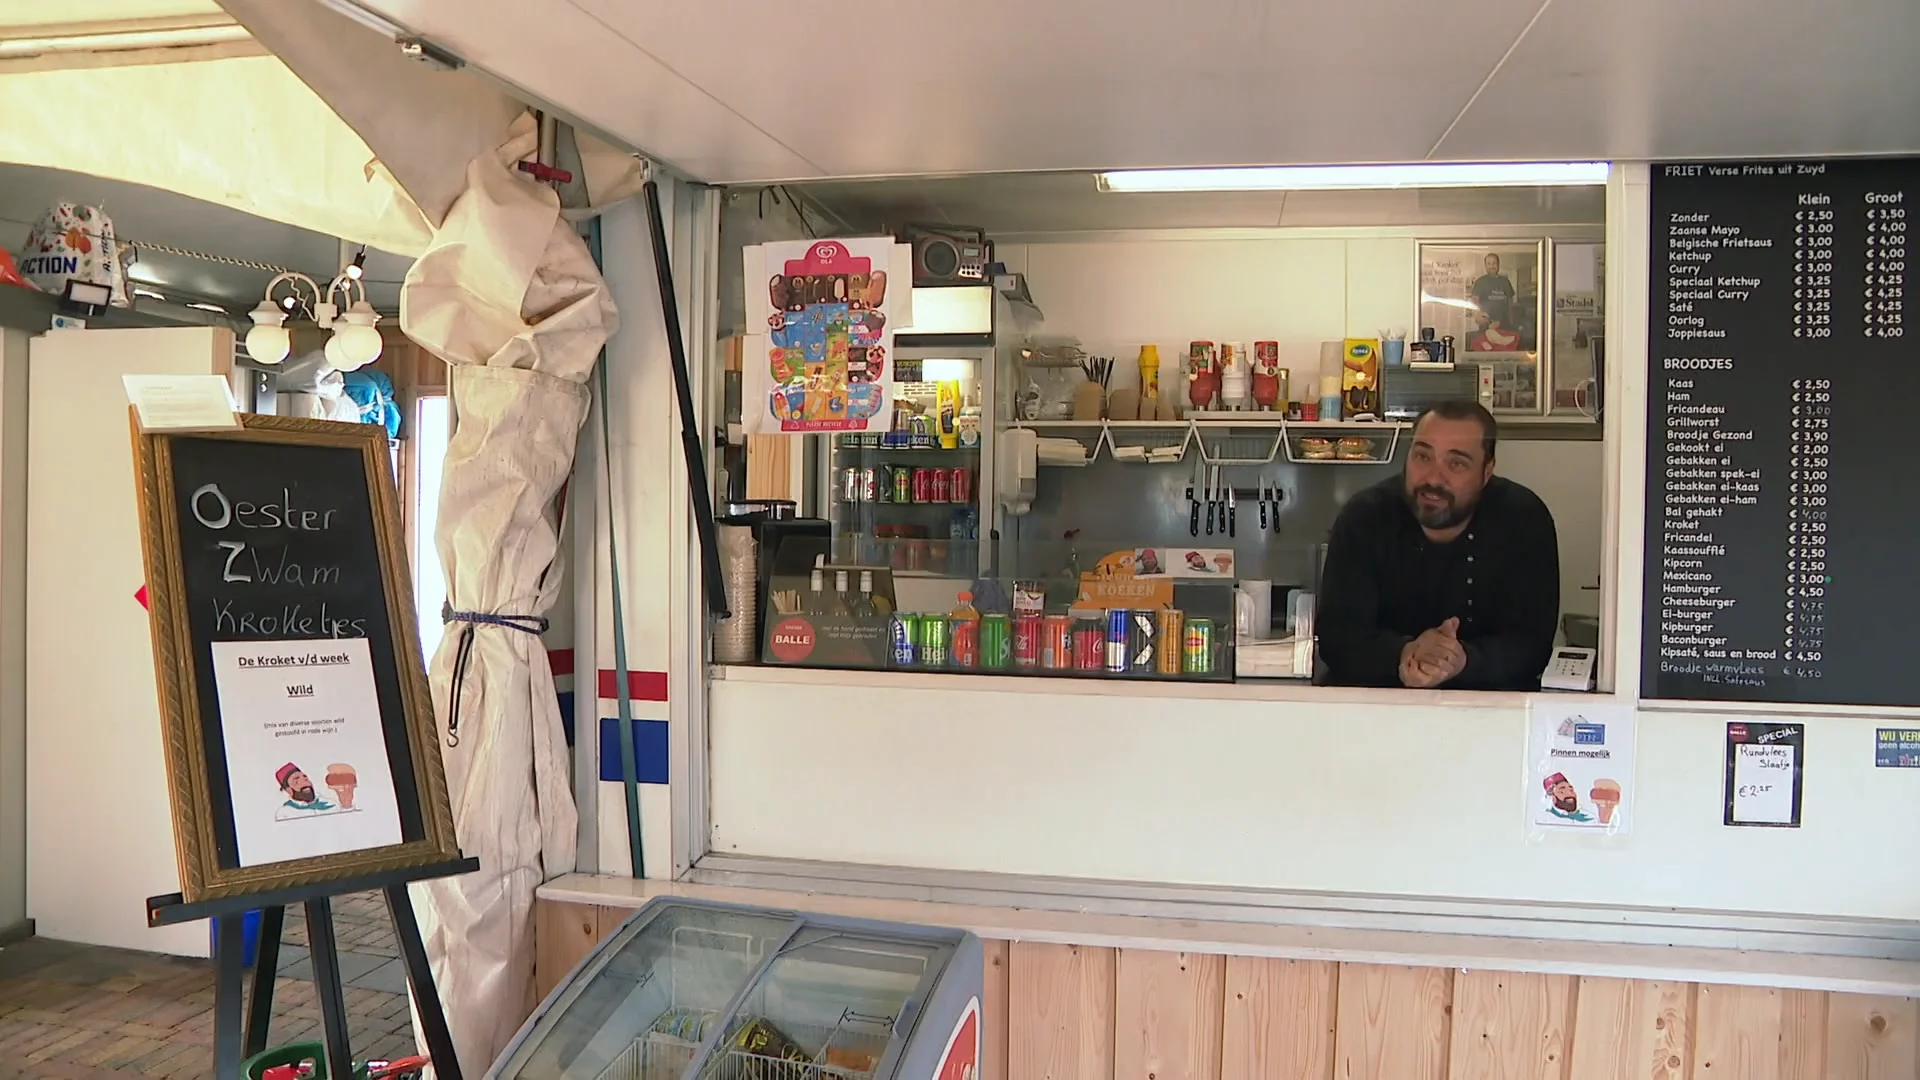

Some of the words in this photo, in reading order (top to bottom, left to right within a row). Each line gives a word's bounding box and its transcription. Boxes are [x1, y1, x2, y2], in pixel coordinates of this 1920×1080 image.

[1665, 166, 1703, 176] FRIET
[1709, 166, 1738, 176] Verse
[1743, 165, 1773, 175] Frites
[1778, 166, 1791, 175] uit
[1798, 164, 1825, 175] Zuyd
[1799, 194, 1830, 205] Klein
[1865, 191, 1903, 204] Groot
[1671, 213, 1710, 222] Zonder
[1808, 211, 1833, 221] 2,50
[1880, 210, 1905, 220] 3,50
[1670, 226, 1707, 236] Zaanse
[1712, 226, 1740, 236] Mayo
[1880, 222, 1905, 232] 4,00
[1670, 238, 1718, 249] Belgische
[1723, 238, 1772, 249] Frietsaus
[1808, 238, 1833, 248] 3,00
[1880, 236, 1905, 246] 4,00
[1669, 252, 1711, 262] Ketchup
[1807, 250, 1832, 260] 3,00
[1879, 249, 1904, 259] 4,00
[20, 256, 78, 274] ACTION
[1669, 265, 1700, 275] Curry
[1807, 263, 1832, 273] 3,00
[1879, 262, 1904, 272] 4,00
[1669, 277, 1713, 288] Speciaal
[1718, 277, 1760, 288] Ketchup
[1807, 276, 1831, 286] 3,25
[1879, 275, 1904, 285] 4,25
[1669, 290, 1712, 301] Speciaal
[1718, 290, 1749, 301] Curry
[1807, 289, 1831, 300] 3,25
[1879, 288, 1904, 299] 4,25
[1669, 302, 1693, 312] Saté
[1807, 302, 1830, 313] 3,25
[1878, 301, 1903, 312] 4,25
[1669, 316, 1704, 327] Oorlog
[1806, 315, 1830, 325] 3,25
[1878, 314, 1903, 324] 4,25
[1668, 328, 1725, 339] Joppiesaus
[1806, 328, 1831, 339] 3,00
[1878, 326, 1903, 337] 4,00
[1664, 359, 1733, 369] BROODJES
[1669, 379, 1694, 388] Kaas
[1805, 380, 1830, 390] 2,50
[1668, 392, 1690, 401] Ham
[1805, 393, 1830, 402] 2,50
[1668, 405, 1725, 414] Fricandeau
[1667, 417, 1720, 426] Grillworst
[1804, 419, 1828, 428] 2,75
[1668, 430, 1708, 440] Broodje
[1713, 430, 1753, 440] Gezond
[1804, 432, 1828, 441] 3,90
[1667, 443, 1710, 452] Gekookt
[1804, 446, 1829, 455] 2,00
[1667, 456, 1716, 465] Gebakken
[1803, 458, 1828, 468] 2,50
[1666, 469, 1716, 479] Gebakken
[1803, 471, 1827, 480] 3,00
[1666, 482, 1716, 491] Gebakken
[1803, 484, 1827, 493] 3,00
[191, 483, 337, 530] Oester
[1665, 495, 1716, 504] Gebakken
[1802, 497, 1826, 506] 3,00
[1665, 507, 1681, 517] Bal
[1686, 507, 1723, 517] gehakt
[1665, 520, 1699, 529] Kroket
[1802, 523, 1826, 532] 2,50
[1665, 533, 1712, 542] Fricandel
[1801, 536, 1826, 546] 2,50
[1664, 545, 1725, 555] Kaassoufflé
[1801, 549, 1825, 559] 2,50
[1664, 559, 1702, 569] Kipcorn
[1800, 562, 1825, 571] 2,50
[1663, 572, 1712, 581] Mexicano
[1800, 575, 1824, 584] 3,00
[1663, 584, 1721, 595] Hamburger
[1799, 588, 1823, 597] 4,50
[1663, 597, 1735, 607] Cheeseburger
[1662, 623, 1714, 633] Kipburger
[775, 634, 811, 645] BALLE
[1662, 636, 1727, 646] Baconburger
[238, 656, 254, 666] De
[258, 656, 295, 666] Kroket
[298, 654, 318, 666] v/d
[320, 652, 350, 664] week
[1661, 649, 1700, 659] Kipsaté,
[1704, 649, 1726, 659] saus
[1730, 649, 1742, 659] en
[1747, 649, 1776, 659] brood
[1797, 652, 1822, 661] 4,50
[286, 684, 314, 696] Wild
[1757, 727, 1798, 744] SPECIAL
[1879, 731, 1896, 741] WIJ
[1551, 748, 1576, 757] Pinnen
[1578, 750, 1610, 759] mogelijk
[1740, 745, 1788, 757] Rundvlees
